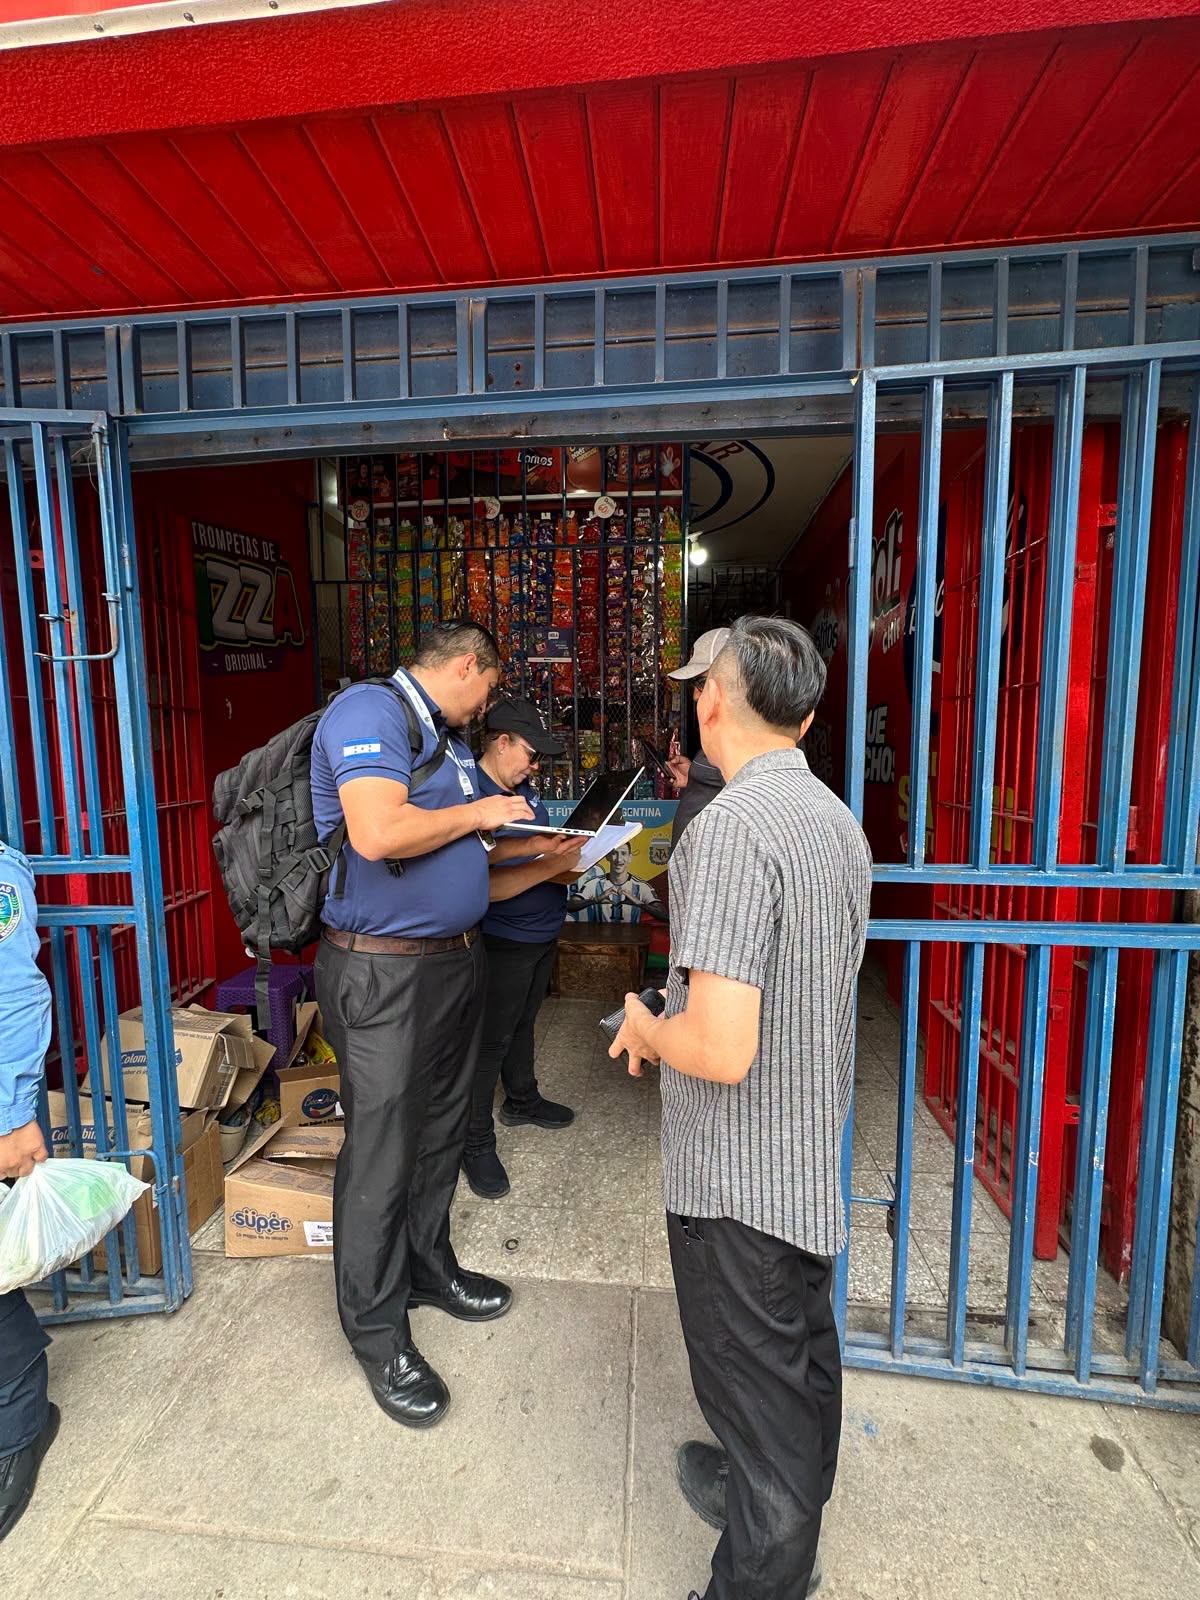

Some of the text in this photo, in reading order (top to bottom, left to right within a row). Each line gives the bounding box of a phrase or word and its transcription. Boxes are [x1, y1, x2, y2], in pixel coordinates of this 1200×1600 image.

[192, 521, 277, 562] TROMPETAS DE
[224, 652, 268, 673] ORIGINAL
[866, 704, 888, 745] UE
[556, 805, 576, 817] FÚT
[0, 884, 12, 893] AS
